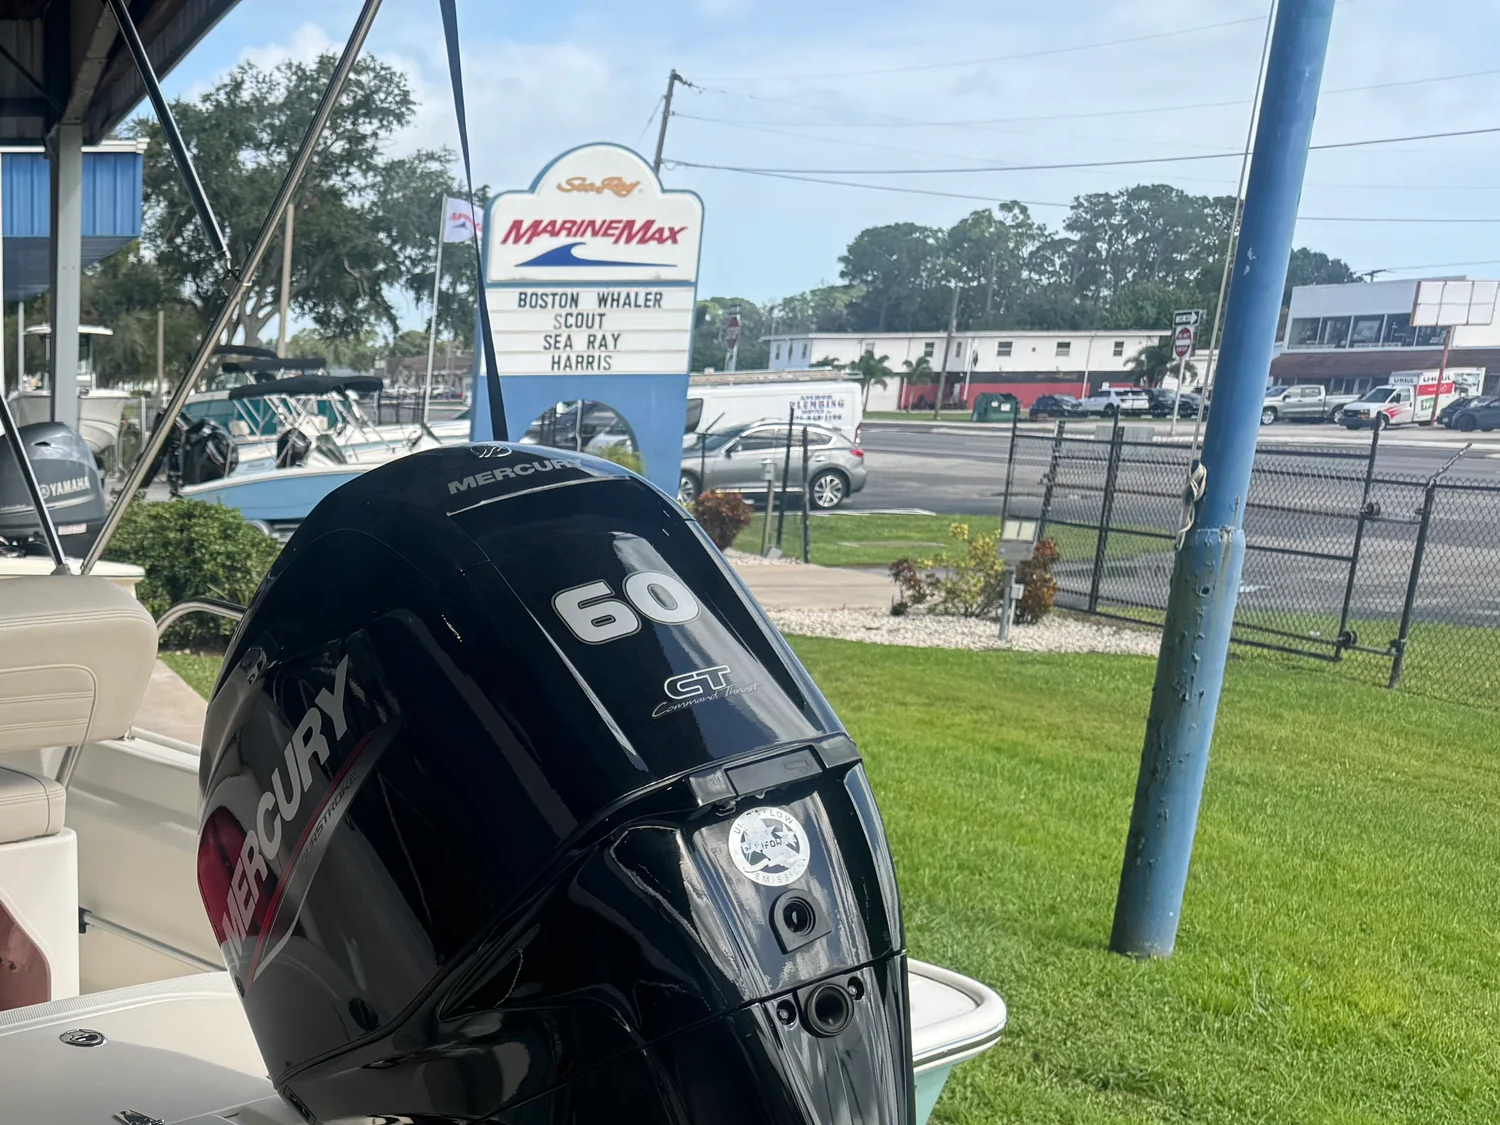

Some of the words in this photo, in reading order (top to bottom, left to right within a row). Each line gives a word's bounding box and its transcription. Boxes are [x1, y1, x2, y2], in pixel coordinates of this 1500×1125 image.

[518, 292, 579, 308] BOSTON
[597, 292, 663, 308] WHALER
[553, 313, 606, 329] SCOUT
[543, 334, 573, 350] SEA
[587, 334, 621, 350] RAY
[551, 355, 612, 371] HARRIS
[50, 476, 90, 496] YAMAHA
[448, 458, 583, 495] MERCURY
[551, 570, 701, 645] 60
[664, 665, 730, 700] CT
[652, 691, 718, 718] Command
[221, 654, 349, 970] MERCURY
